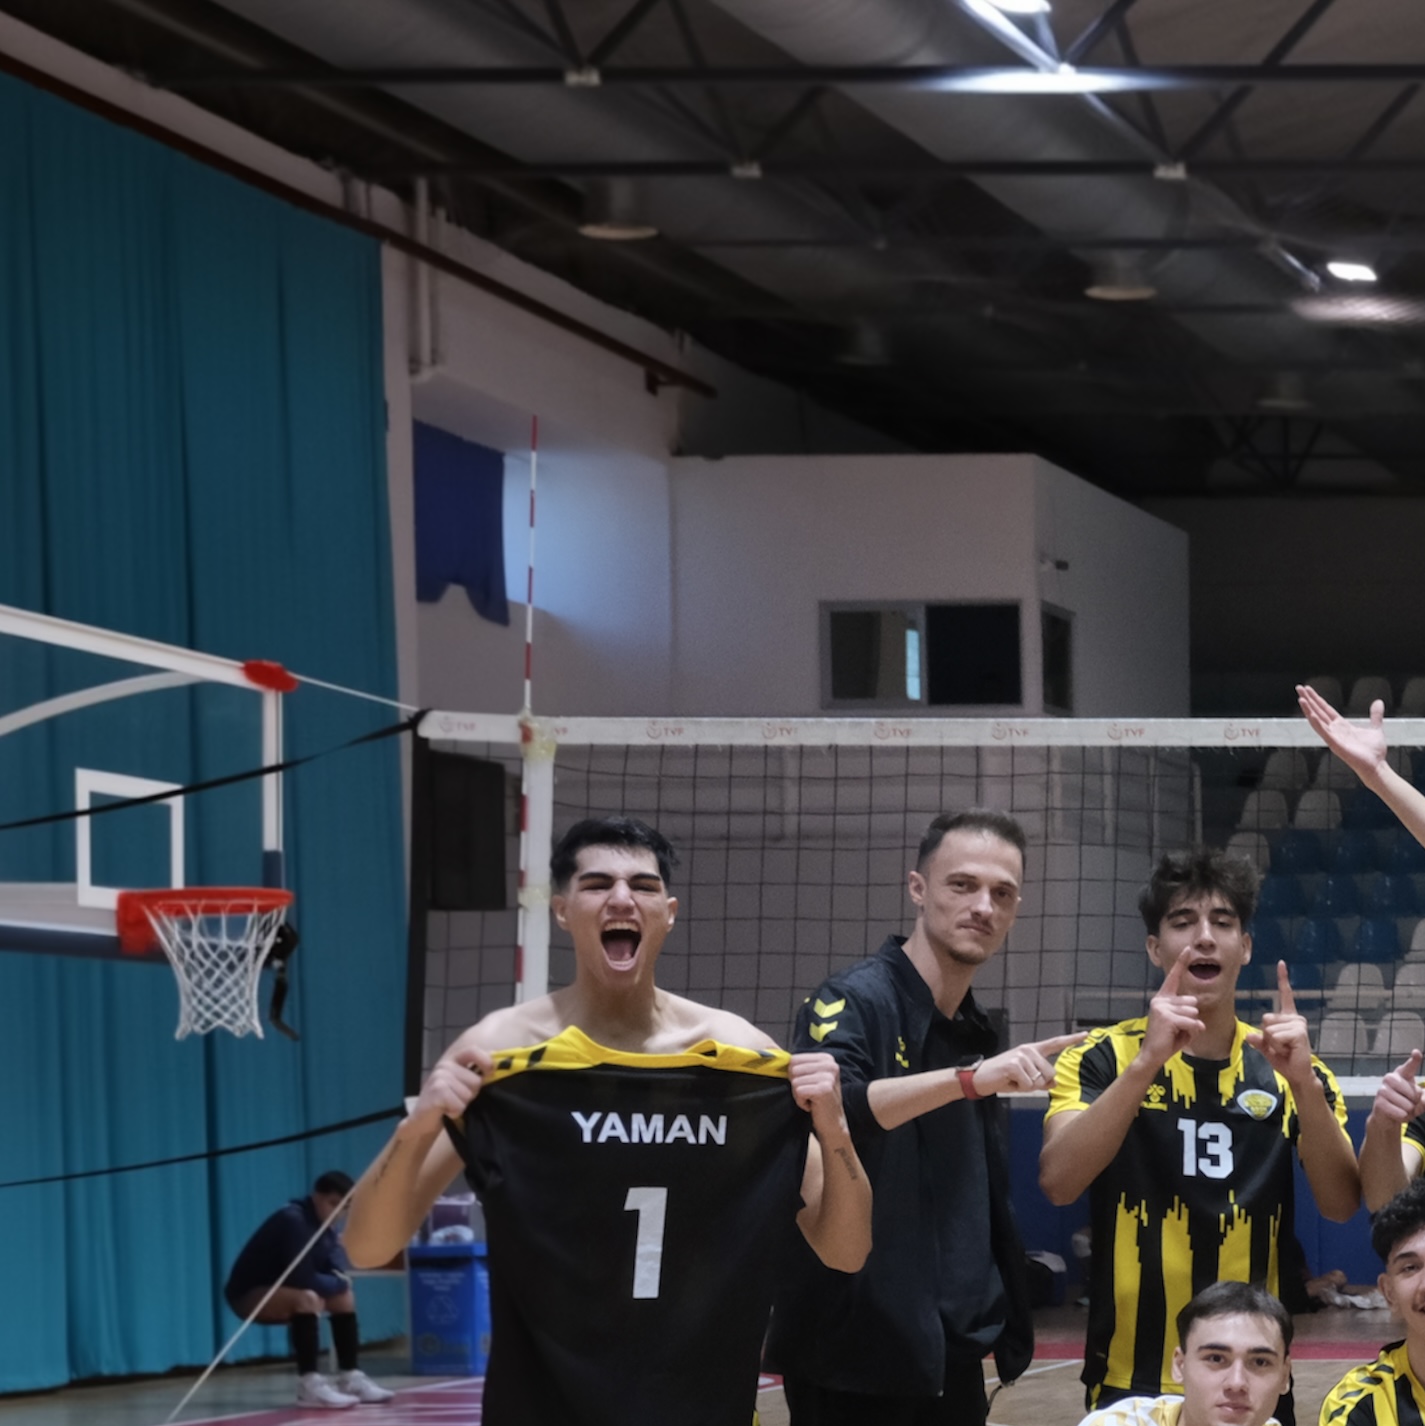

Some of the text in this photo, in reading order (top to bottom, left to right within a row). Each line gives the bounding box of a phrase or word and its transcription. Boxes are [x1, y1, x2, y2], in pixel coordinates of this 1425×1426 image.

[1240, 727, 1262, 738] TVF
[571, 1111, 728, 1146] YAMAN
[1177, 1117, 1234, 1179] 13
[623, 1186, 668, 1299] 1
